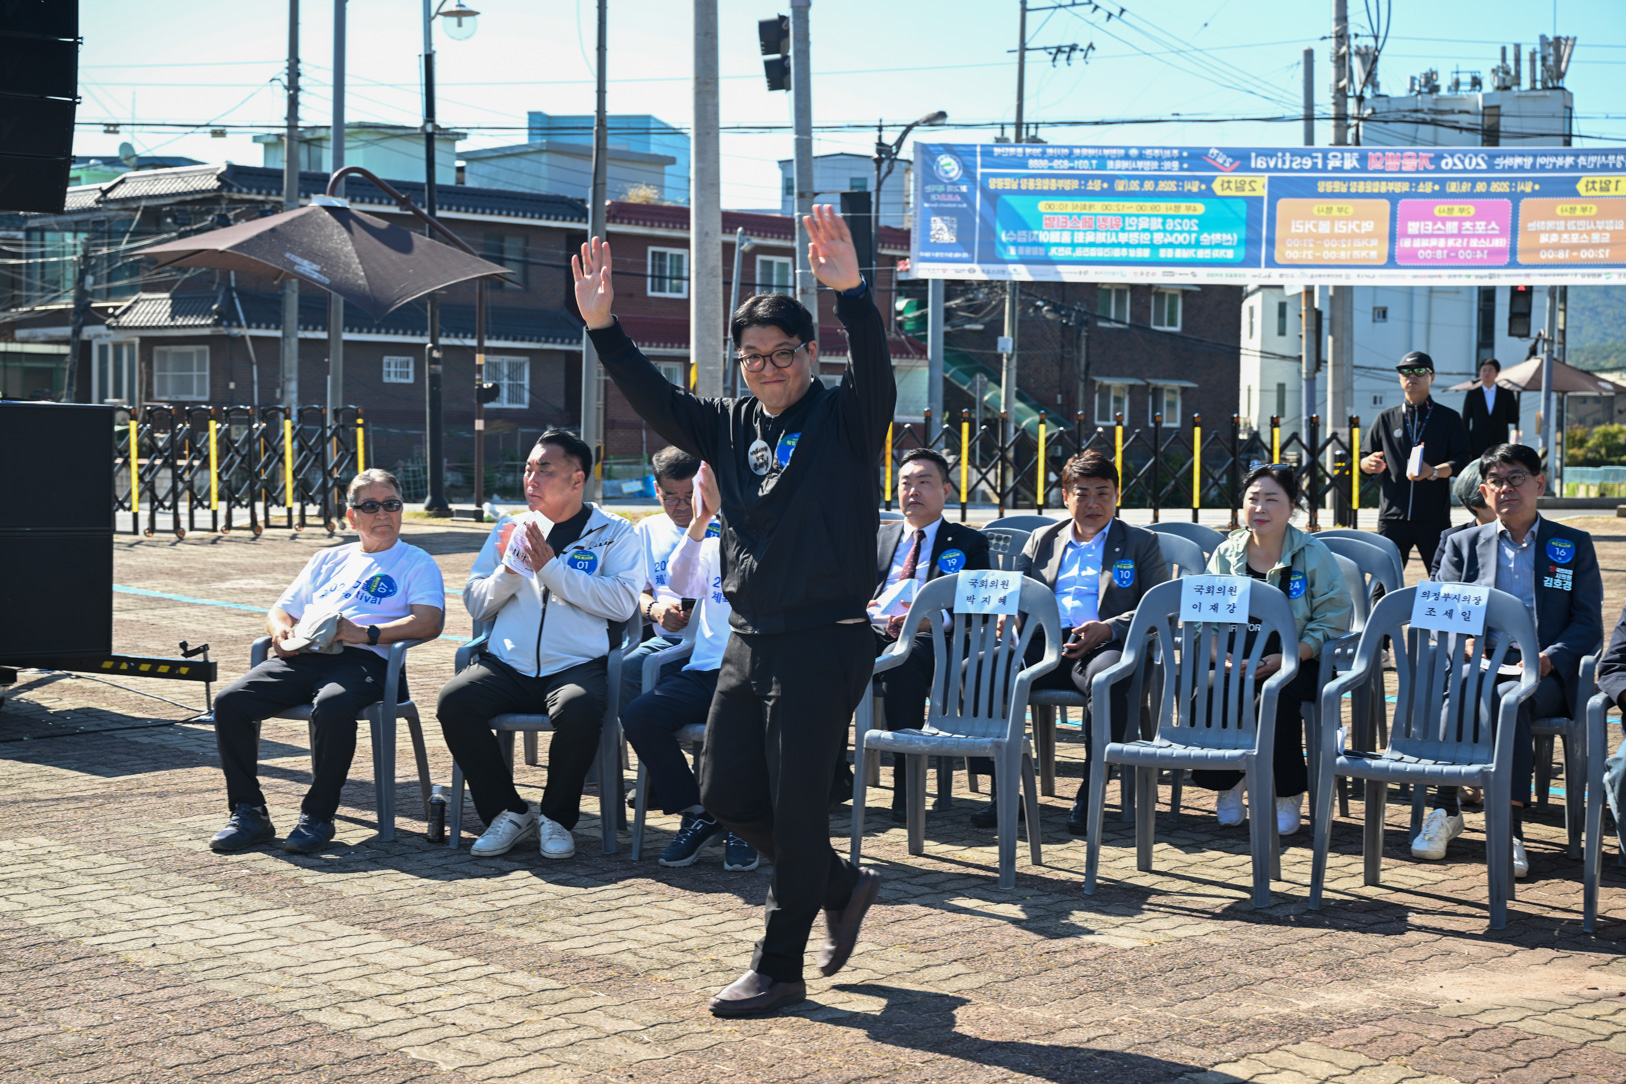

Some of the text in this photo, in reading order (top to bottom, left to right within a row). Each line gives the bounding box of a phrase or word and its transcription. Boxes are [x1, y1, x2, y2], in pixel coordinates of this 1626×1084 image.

[1555, 547, 1566, 556] 16
[576, 561, 589, 570] 01
[947, 558, 958, 566] 19
[1120, 570, 1130, 578] 10
[377, 582, 388, 594] 07
[968, 578, 1010, 590] 국회의원
[1194, 584, 1238, 596] 국회의원
[1544, 576, 1572, 592] 김호경
[1421, 590, 1482, 606] 의정부시의장
